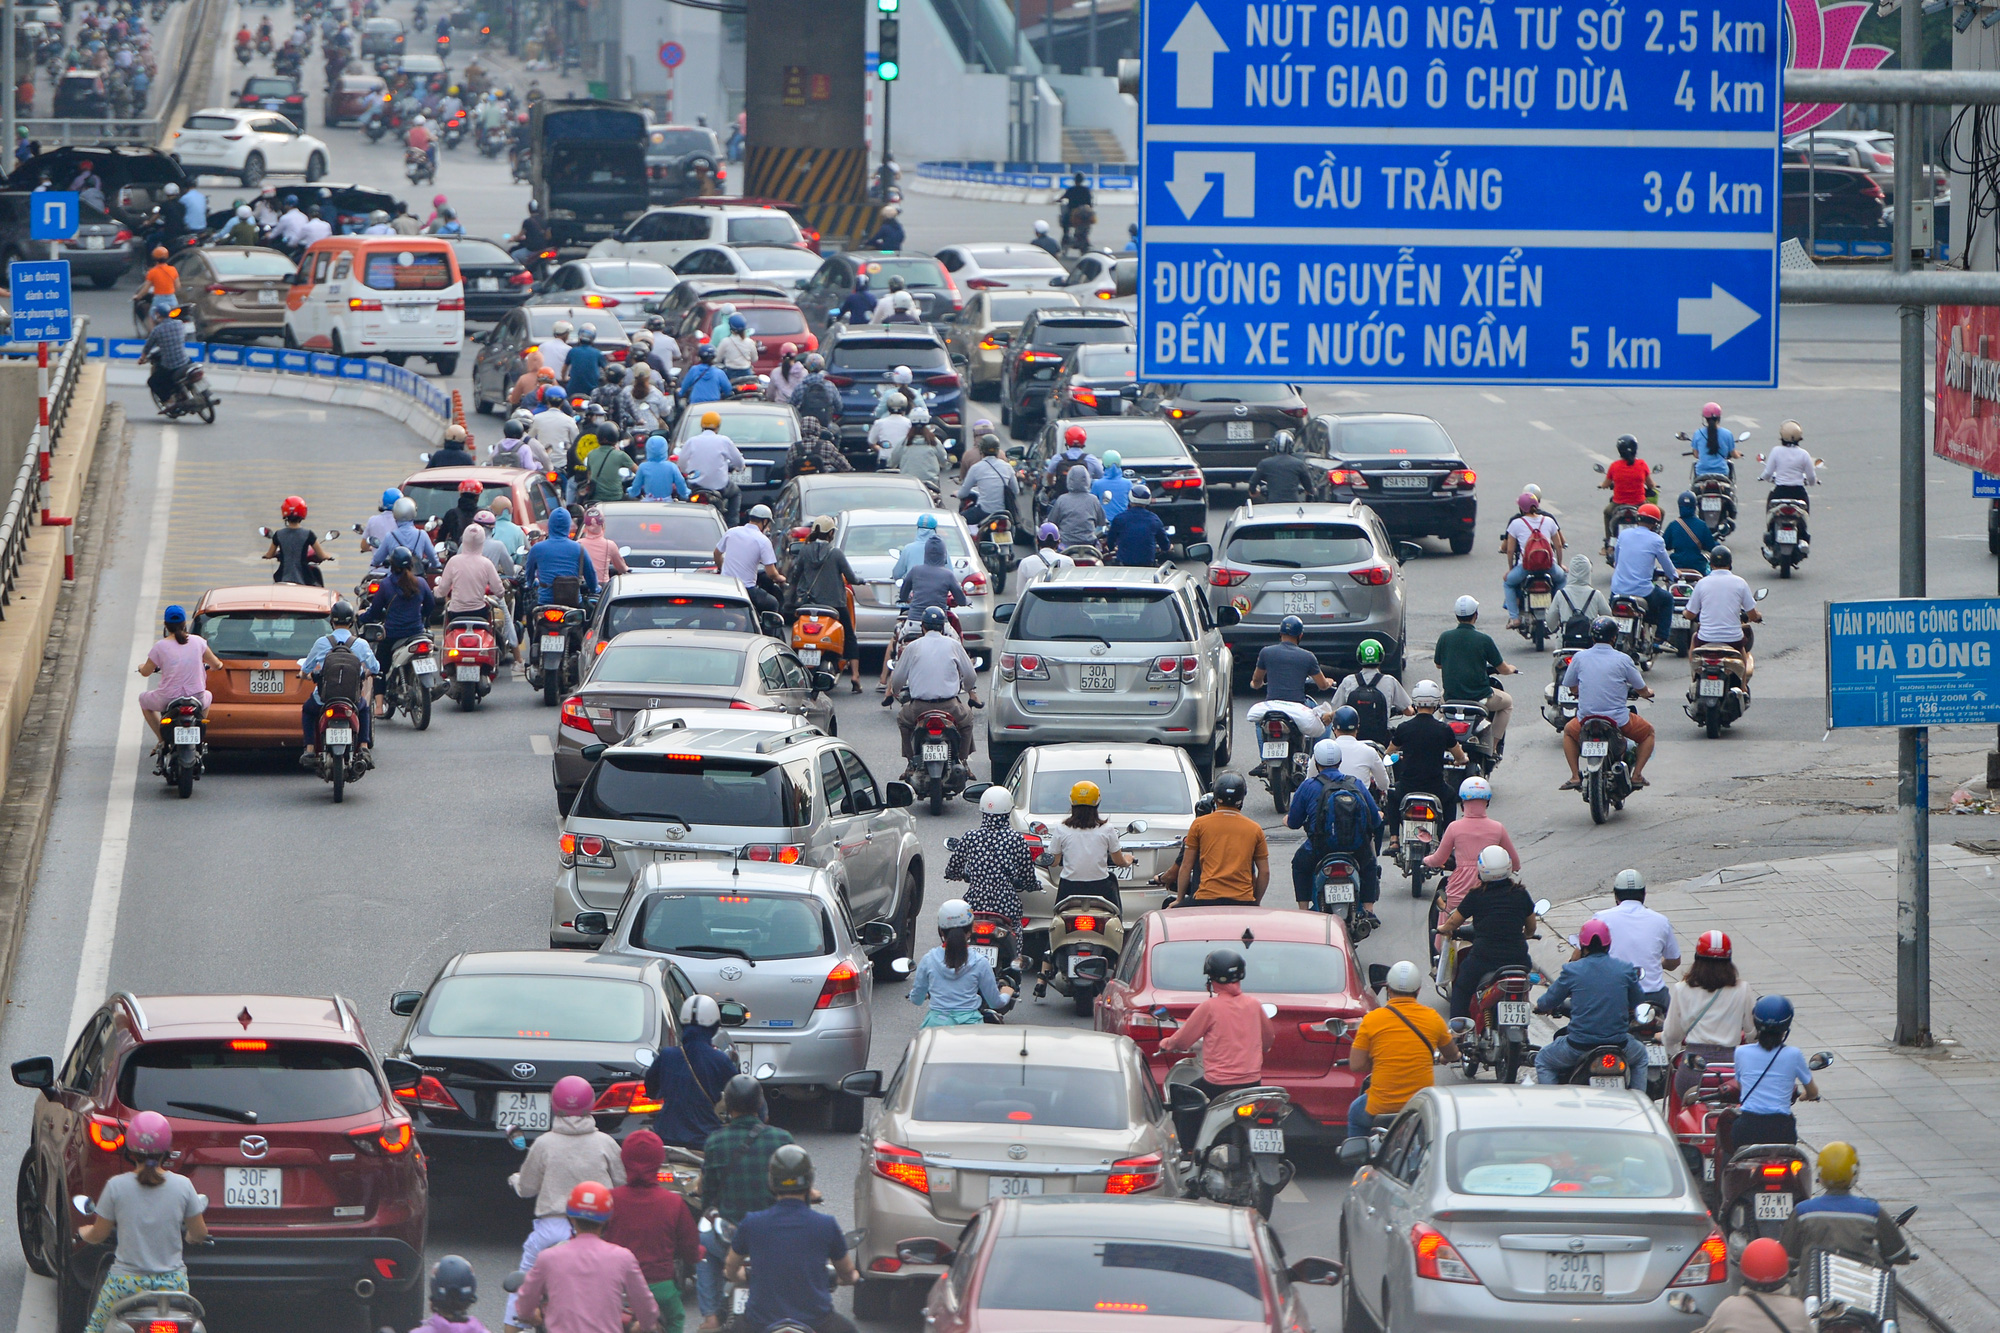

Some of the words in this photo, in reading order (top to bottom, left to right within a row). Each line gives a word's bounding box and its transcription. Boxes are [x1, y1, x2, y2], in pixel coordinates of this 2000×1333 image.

[1247, 0, 1316, 46] NÚT
[1328, 5, 1408, 48] GIAO
[1427, 0, 1498, 49] NGÃ
[1515, 6, 1562, 49] TƯ
[1577, 0, 1625, 50] SỞ
[1645, 10, 1697, 54] 2,5
[1713, 11, 1764, 52] km
[1246, 53, 1315, 107] NÚT
[1327, 65, 1407, 108] GIAO
[1427, 58, 1447, 108] Ô
[1466, 66, 1538, 117] CHỢ
[1557, 57, 1627, 110] DỪA
[1675, 71, 1695, 111] 4
[1711, 71, 1763, 112] km
[1294, 151, 1361, 208] CẦU
[1382, 151, 1502, 210] TRẮNG
[1644, 171, 1694, 216] 3,6
[1709, 172, 1762, 213] km
[1154, 249, 1280, 304] ĐƯỜNG
[1299, 247, 1440, 305] NGUYỄN
[1461, 247, 1542, 306] XIỂN
[45, 290, 59, 299] cho
[1156, 306, 1225, 364] BẾN
[1245, 323, 1289, 364] XE
[1308, 311, 1405, 365] NƯỚC
[1424, 311, 1526, 366] NGẦM
[1571, 327, 1589, 367] 5
[1608, 327, 1660, 368] km
[1292, 593, 1308, 603] 29A
[1285, 604, 1316, 614] 734.55
[1834, 608, 1862, 636] VĂN
[1866, 606, 1915, 635] PHÒNG
[1919, 605, 1958, 634] CÔNG
[1856, 639, 1897, 671] HÀ
[1906, 638, 1990, 670] ĐÔNG
[258, 670, 276, 680] 30A
[1088, 666, 1108, 676] 30A
[250, 682, 284, 692] 398.00
[1081, 676, 1114, 688] 576.20
[1916, 692, 1938, 702] PHẢI
[1941, 694, 1967, 702] 200M
[1918, 702, 1938, 714] 136
[1328, 894, 1352, 902] 180.47
[1504, 1004, 1526, 1013] 19-K6
[1504, 1013, 1526, 1024] 2476
[1595, 1078, 1619, 1088] 59-S1
[510, 1094, 537, 1110] 29A
[500, 1112, 548, 1128] 275.98
[1255, 1130, 1278, 1140] 29-T1
[1254, 1140, 1283, 1152] 462.72
[240, 1169, 268, 1186] 30F
[1002, 1179, 1030, 1195] 30A
[227, 1187, 278, 1205] 049.31
[1561, 1256, 1588, 1272] 30A
[1548, 1274, 1602, 1291] 844.76
